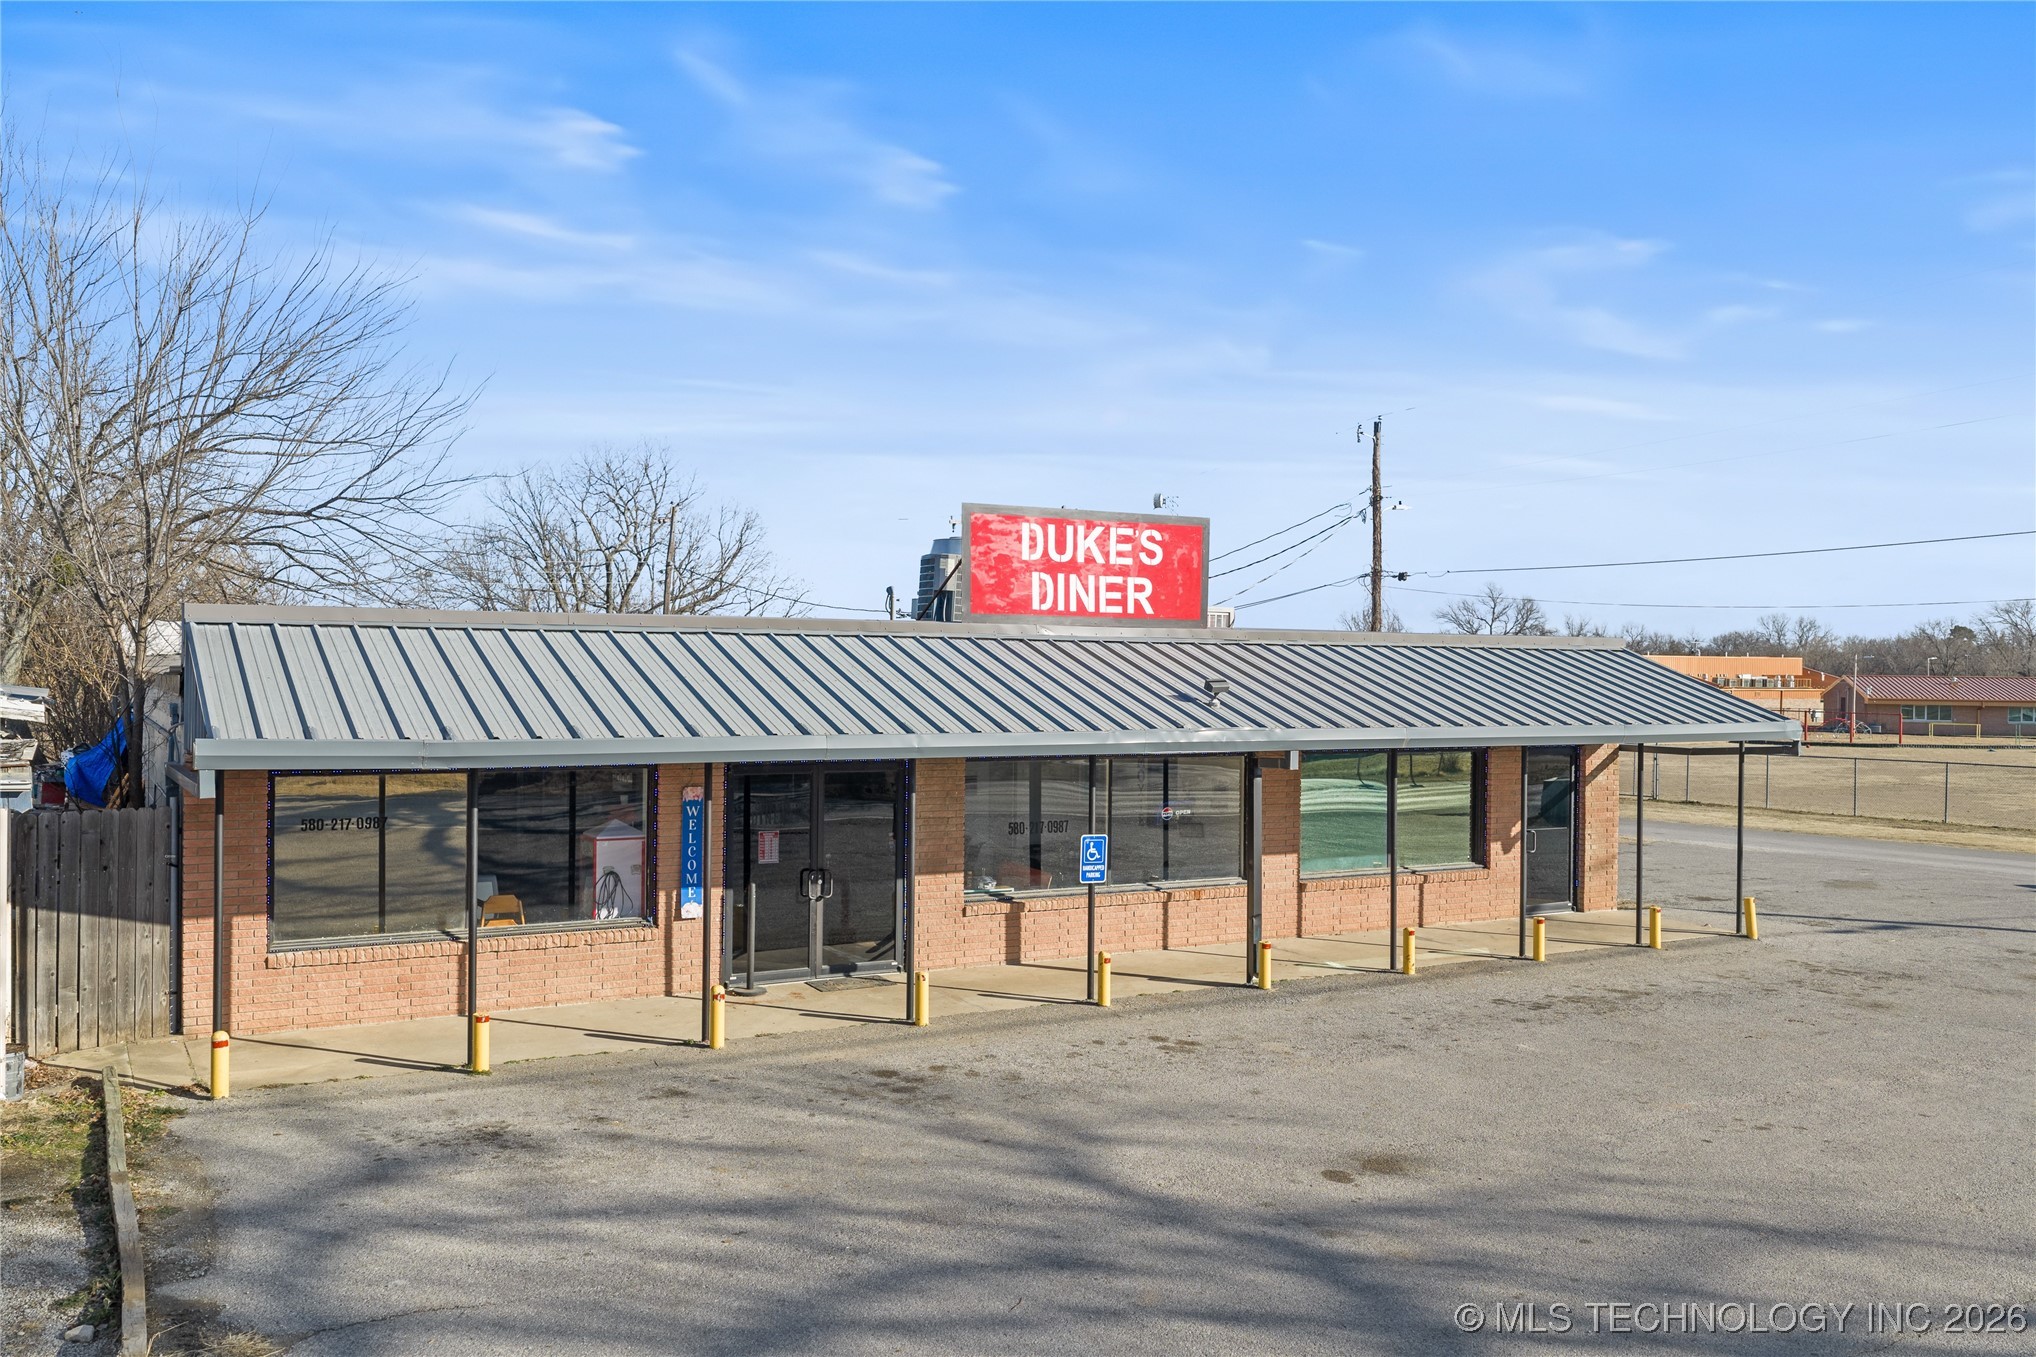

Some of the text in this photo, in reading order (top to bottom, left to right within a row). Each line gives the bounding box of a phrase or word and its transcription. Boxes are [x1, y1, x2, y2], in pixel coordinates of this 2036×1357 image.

[1021, 522, 1164, 566] DUKE'S
[1031, 572, 1155, 615] DINER
[686, 805, 701, 898] WELCOME
